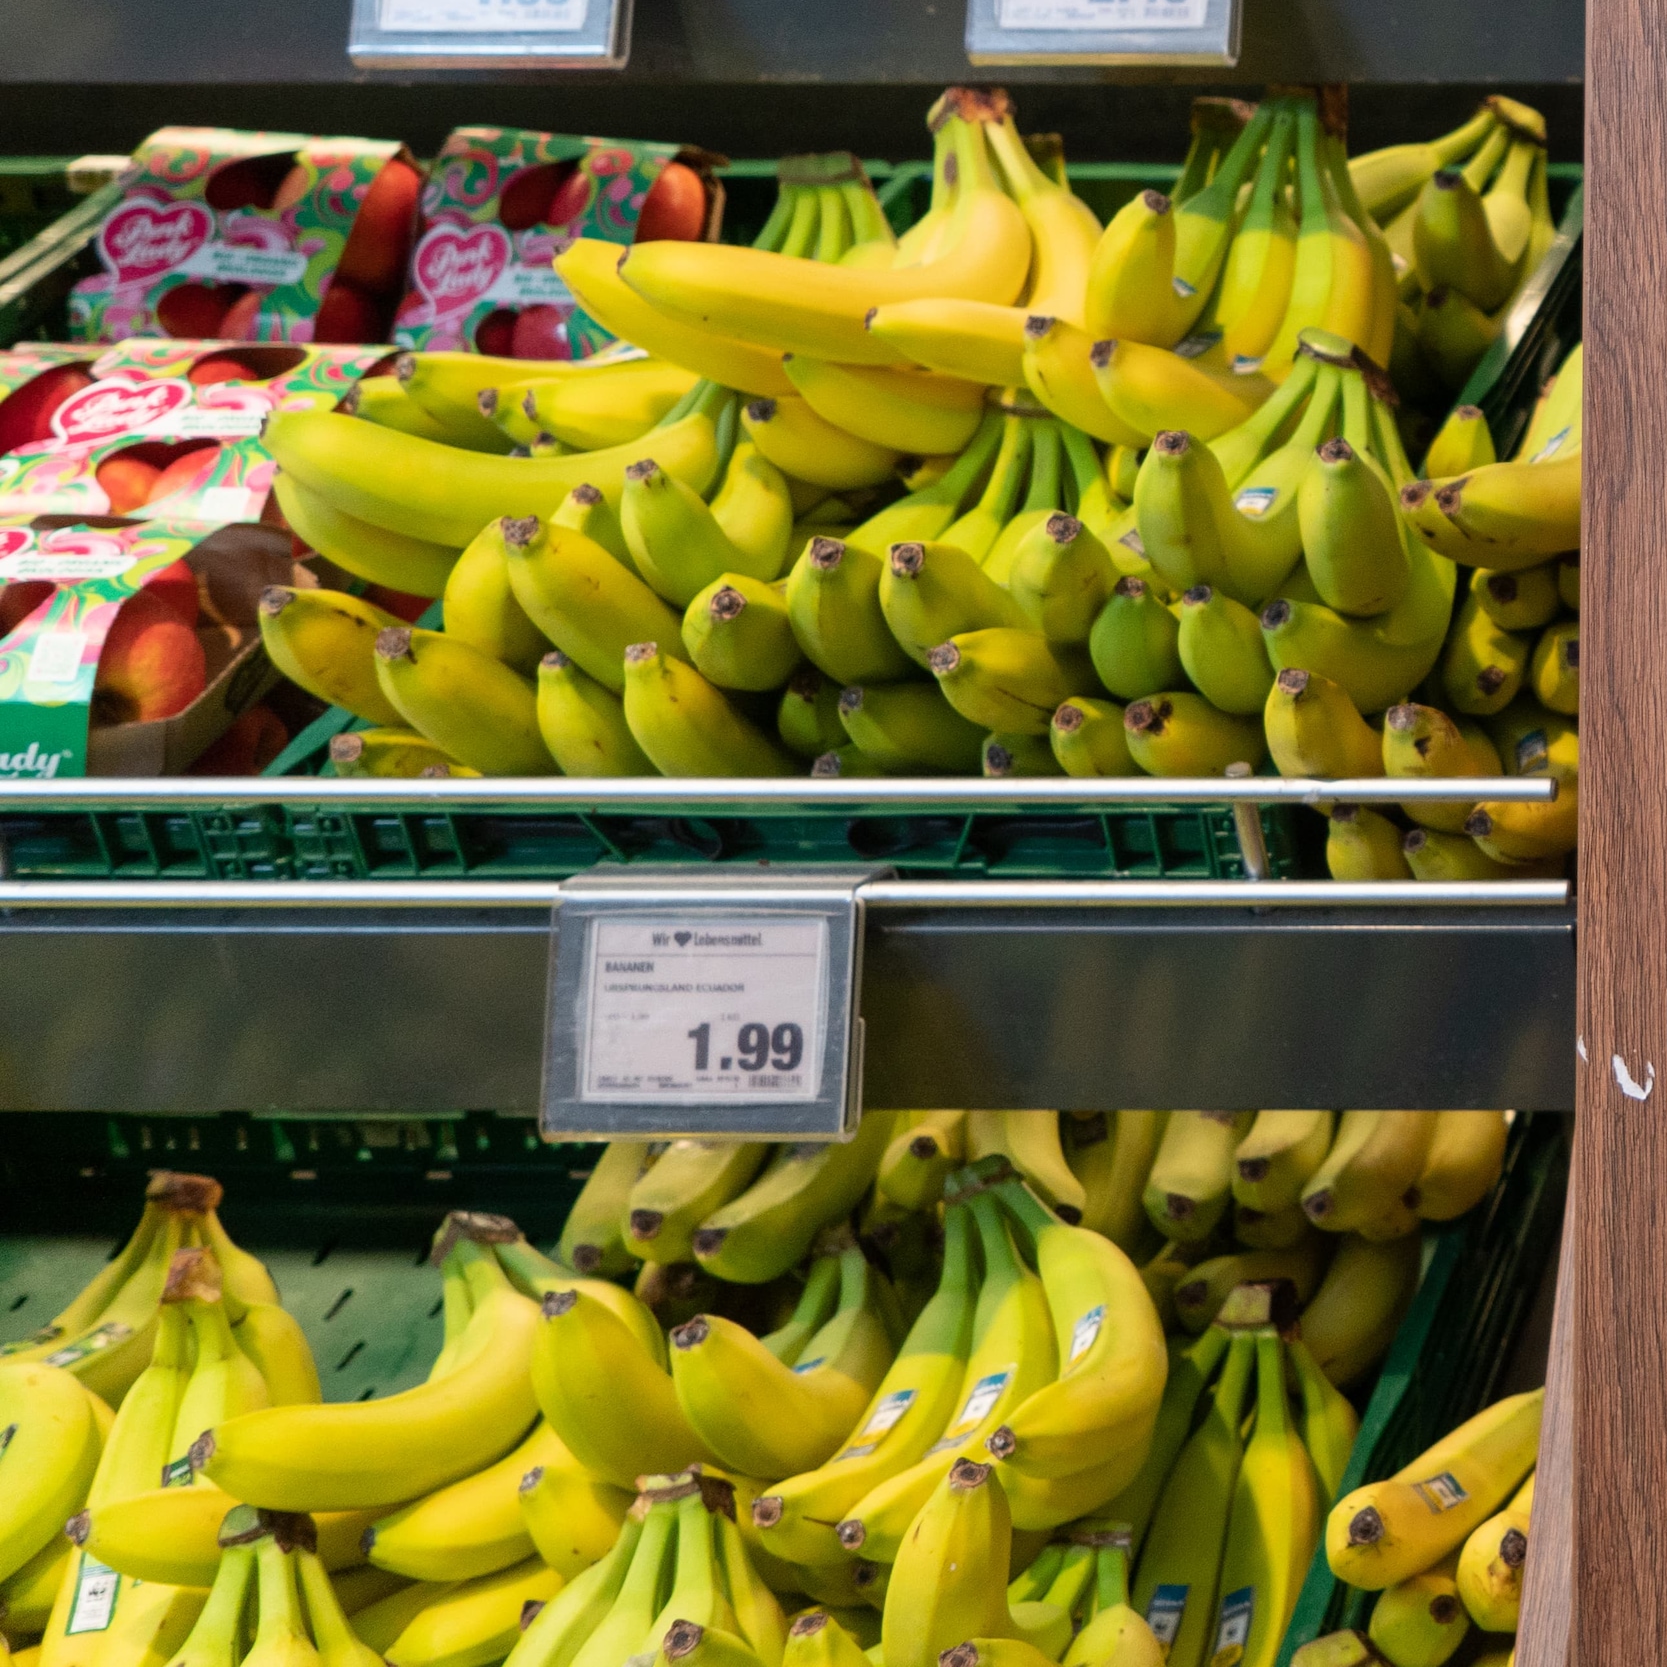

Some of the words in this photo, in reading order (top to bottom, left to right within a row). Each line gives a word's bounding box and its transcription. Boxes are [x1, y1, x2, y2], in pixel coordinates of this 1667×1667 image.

[652, 931, 671, 948] Wir
[604, 960, 655, 974] BANANEN
[687, 1022, 804, 1071] 1.99
